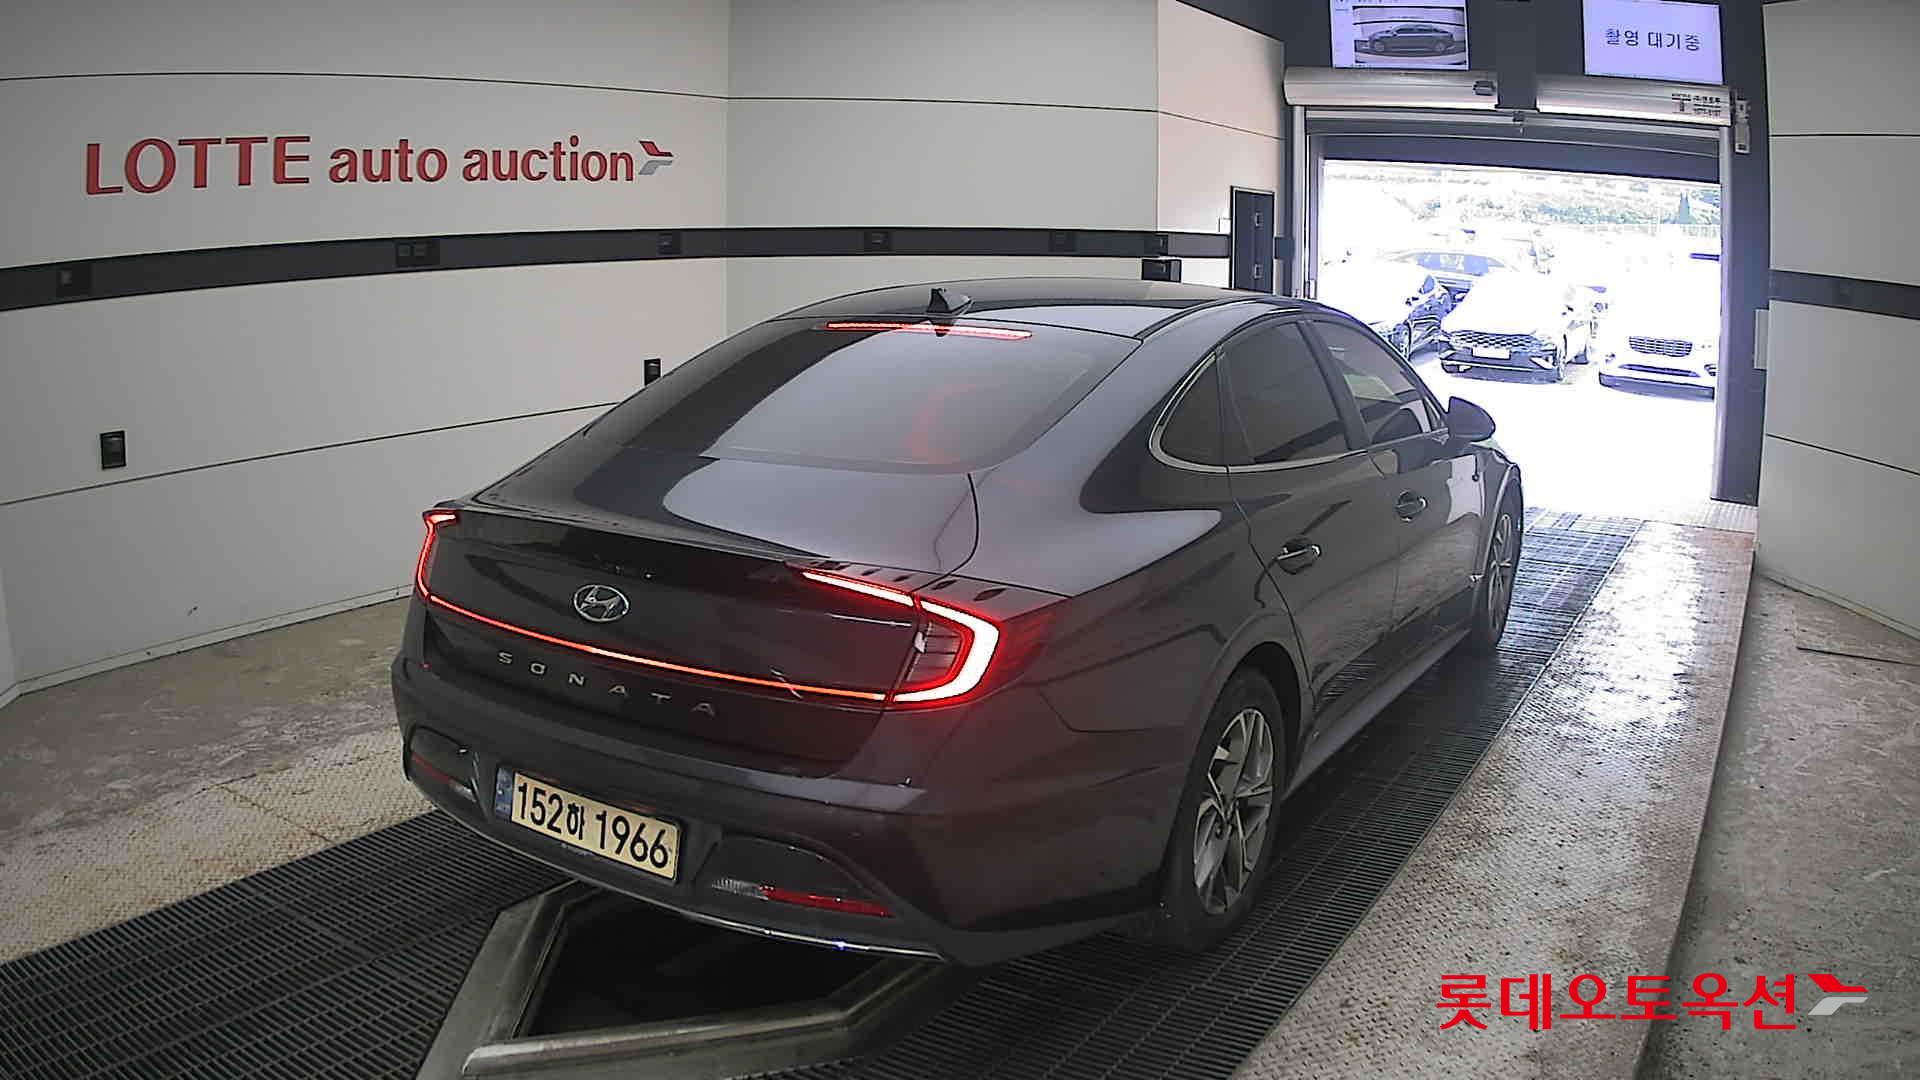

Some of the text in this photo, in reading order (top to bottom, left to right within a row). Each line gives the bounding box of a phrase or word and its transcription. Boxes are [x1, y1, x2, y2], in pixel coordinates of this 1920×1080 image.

[1648, 31, 1700, 51] 대기중
[86, 135, 634, 195] LOTTE auto auction
[498, 651, 714, 716] SONATA
[518, 782, 669, 869] 152하 1966
